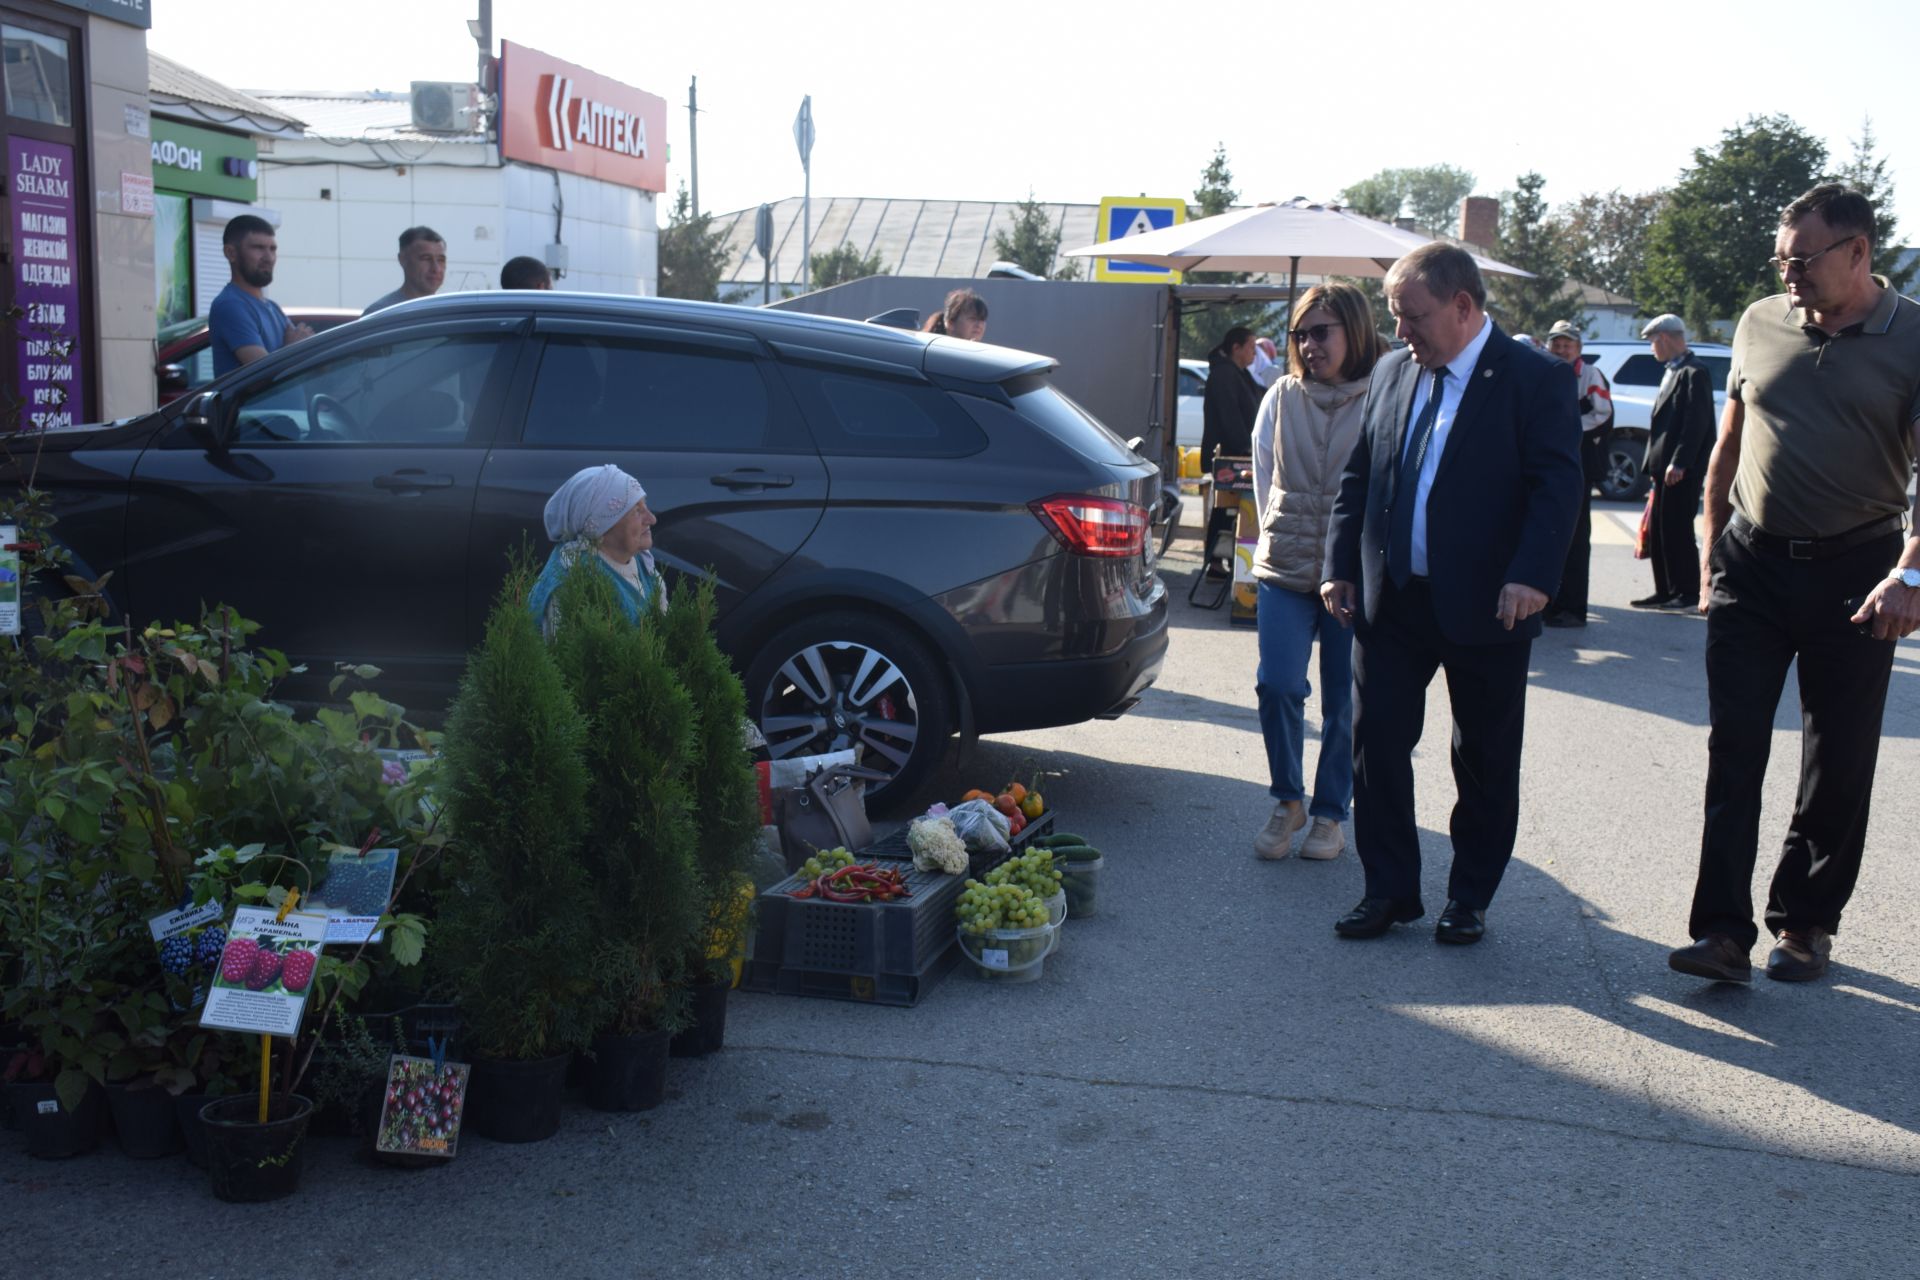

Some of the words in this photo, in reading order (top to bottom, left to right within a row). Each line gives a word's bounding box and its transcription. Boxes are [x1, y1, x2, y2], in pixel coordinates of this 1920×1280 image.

[576, 97, 649, 160] АПТЕКА
[21, 152, 62, 177] LADY
[17, 173, 69, 198] SHARM
[21, 212, 67, 235] МАГАЗИН
[23, 238, 68, 260] ЖЕНСКОЙ
[22, 263, 71, 288] ОДЕЖДЫ
[28, 303, 36, 323] 2
[37, 304, 66, 325] ЭТАЖ
[169, 906, 204, 926] ЕЖЕВИКА
[261, 918, 300, 929] МАЛИНА
[253, 926, 303, 938] КАРАМЕЛЬКА
